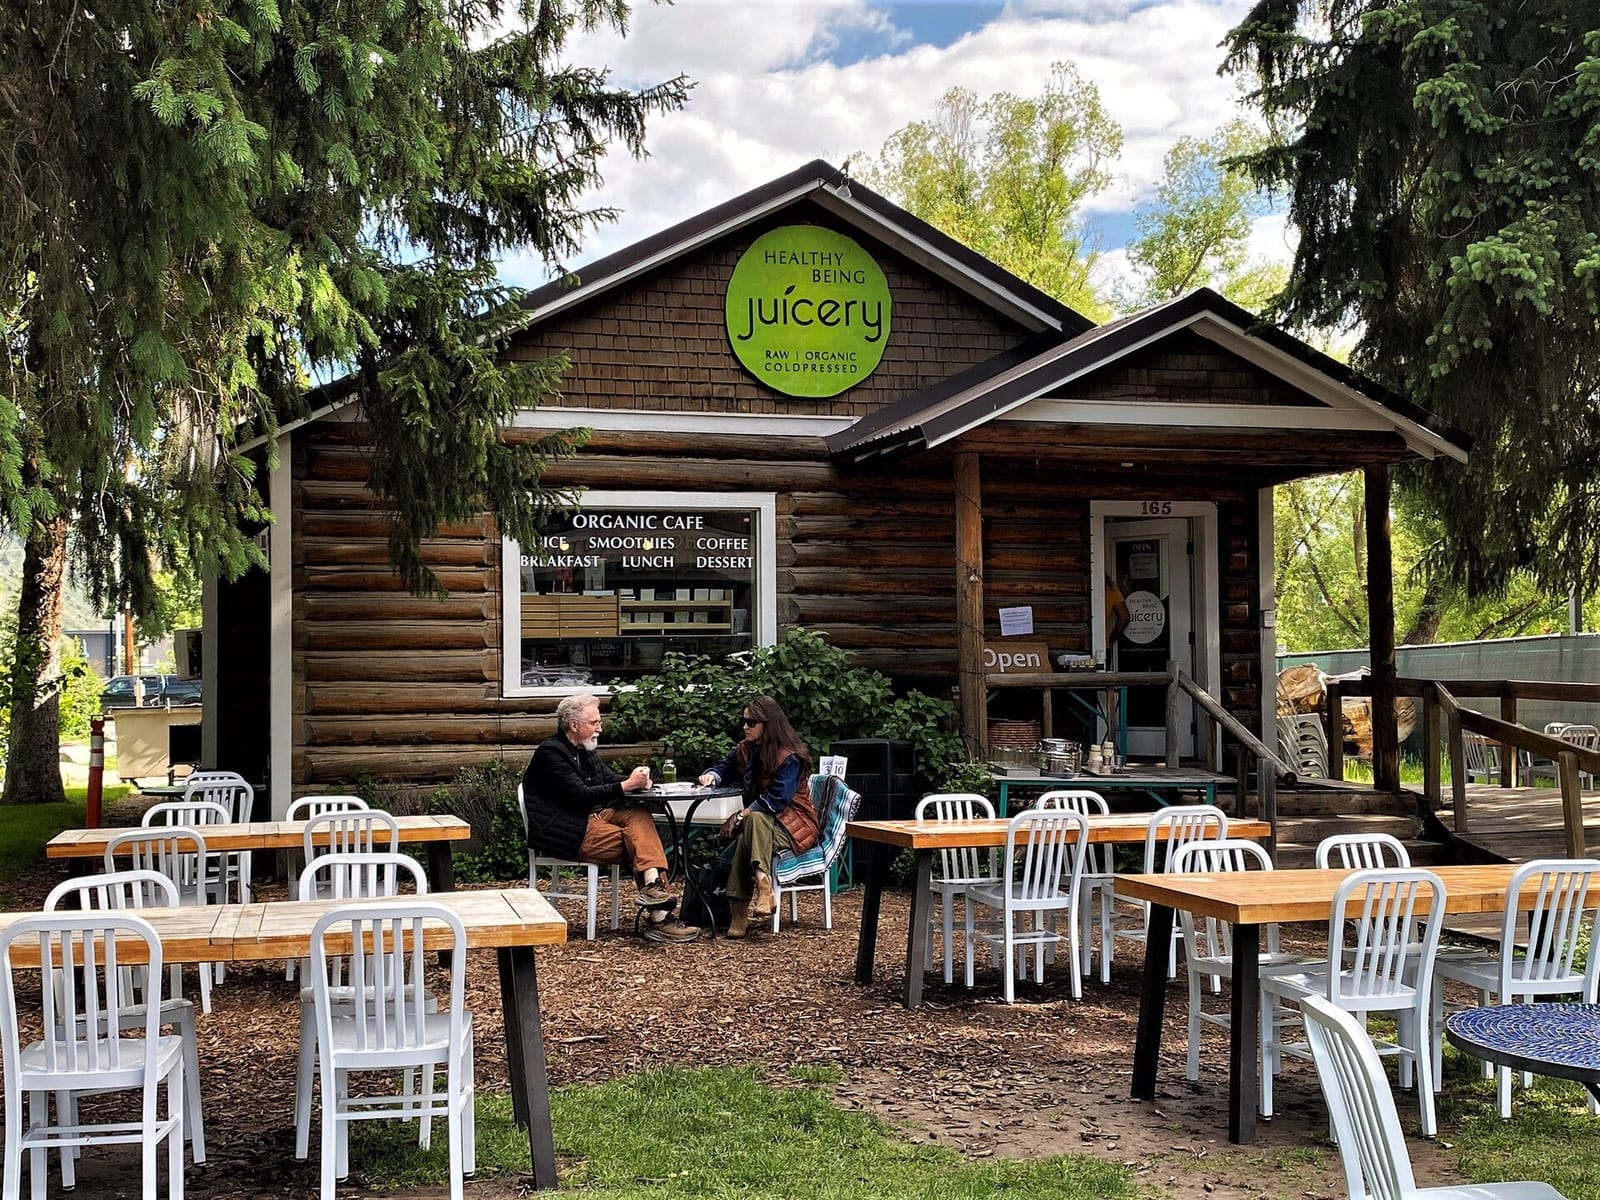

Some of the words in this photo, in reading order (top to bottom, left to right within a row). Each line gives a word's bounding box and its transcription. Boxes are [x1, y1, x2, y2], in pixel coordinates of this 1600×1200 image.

[764, 250, 844, 266] HEALTHY
[812, 269, 866, 285] BEING
[737, 285, 882, 343] juicery
[765, 350, 790, 360] RAW
[805, 351, 857, 362] ORGANIC
[764, 362, 858, 374] COLDPRESSED
[1141, 501, 1172, 515] 165
[572, 514, 657, 530] ORGANIC
[662, 515, 704, 530] CAFE
[589, 536, 675, 550] SMOOTHIES
[696, 538, 749, 550] COFFEE
[622, 555, 675, 568] LUNCH
[696, 556, 754, 568] DESSERT
[983, 648, 1040, 672] Open
